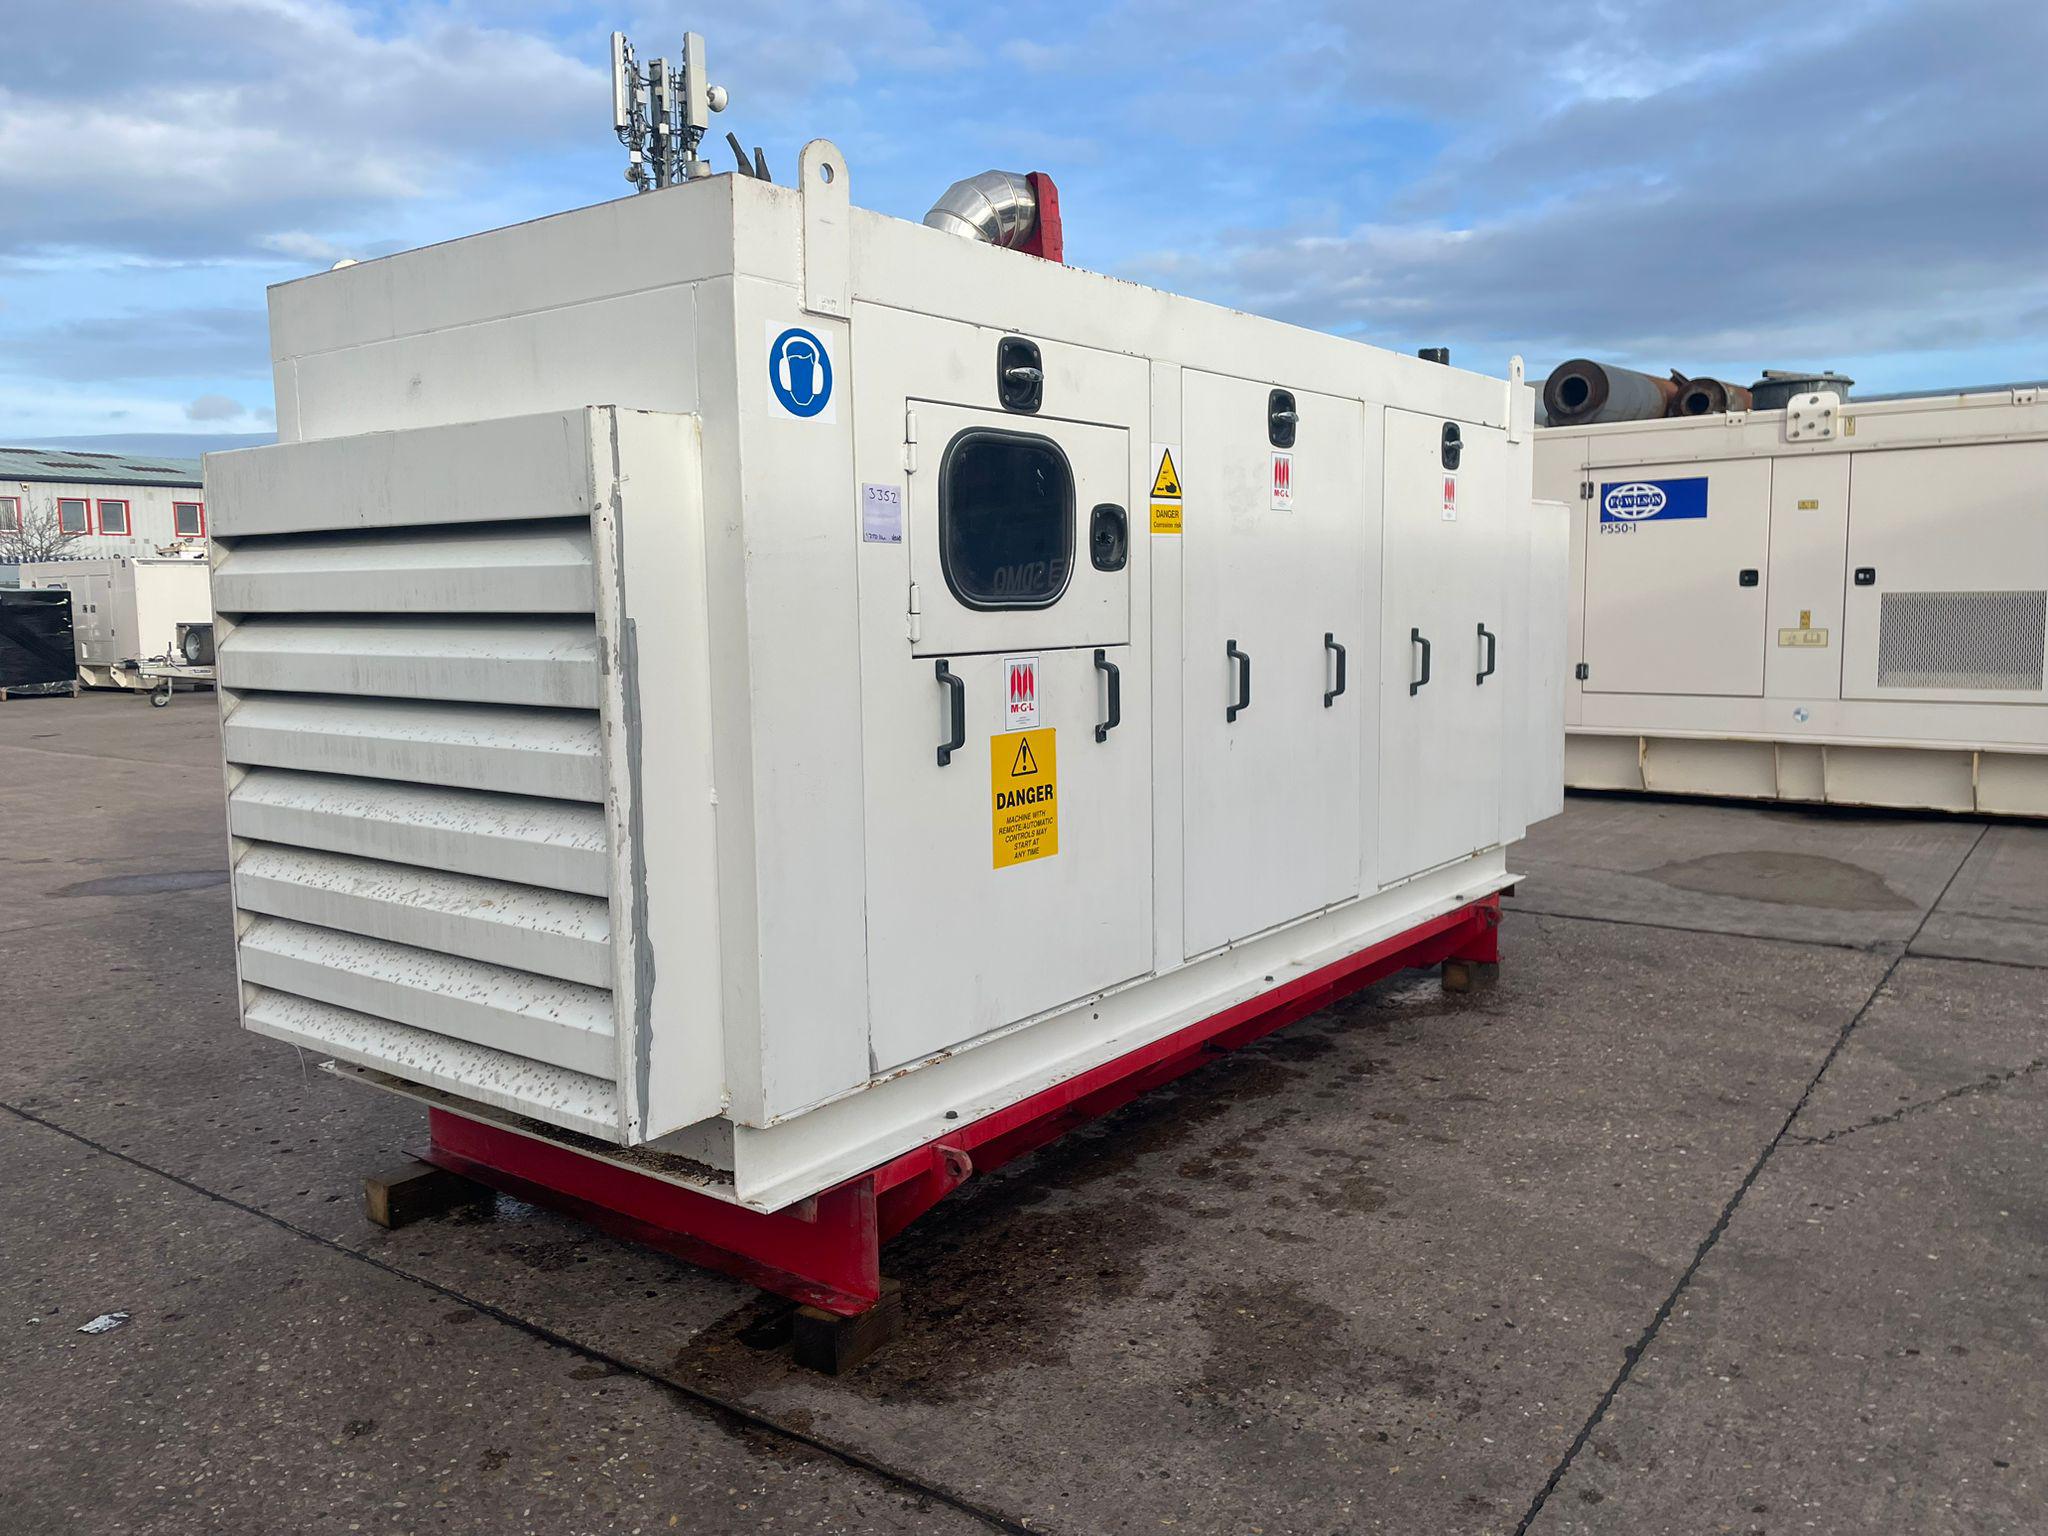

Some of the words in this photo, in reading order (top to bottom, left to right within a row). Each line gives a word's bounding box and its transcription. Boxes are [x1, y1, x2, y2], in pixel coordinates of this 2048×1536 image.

[1624, 493, 1662, 506] WILSON
[1155, 509, 1180, 519] DANGER
[1600, 523, 1637, 535] P550-1
[996, 783, 1054, 810] DANGER
[1006, 812, 1031, 825] MACHINE
[1032, 810, 1046, 818] WITH
[1005, 831, 1036, 843] CONTROLS
[1036, 827, 1048, 836] MAY
[1014, 840, 1032, 850] START
[1033, 838, 1040, 846] AT
[1014, 851, 1026, 860] ANY
[1027, 847, 1040, 857] TIME
